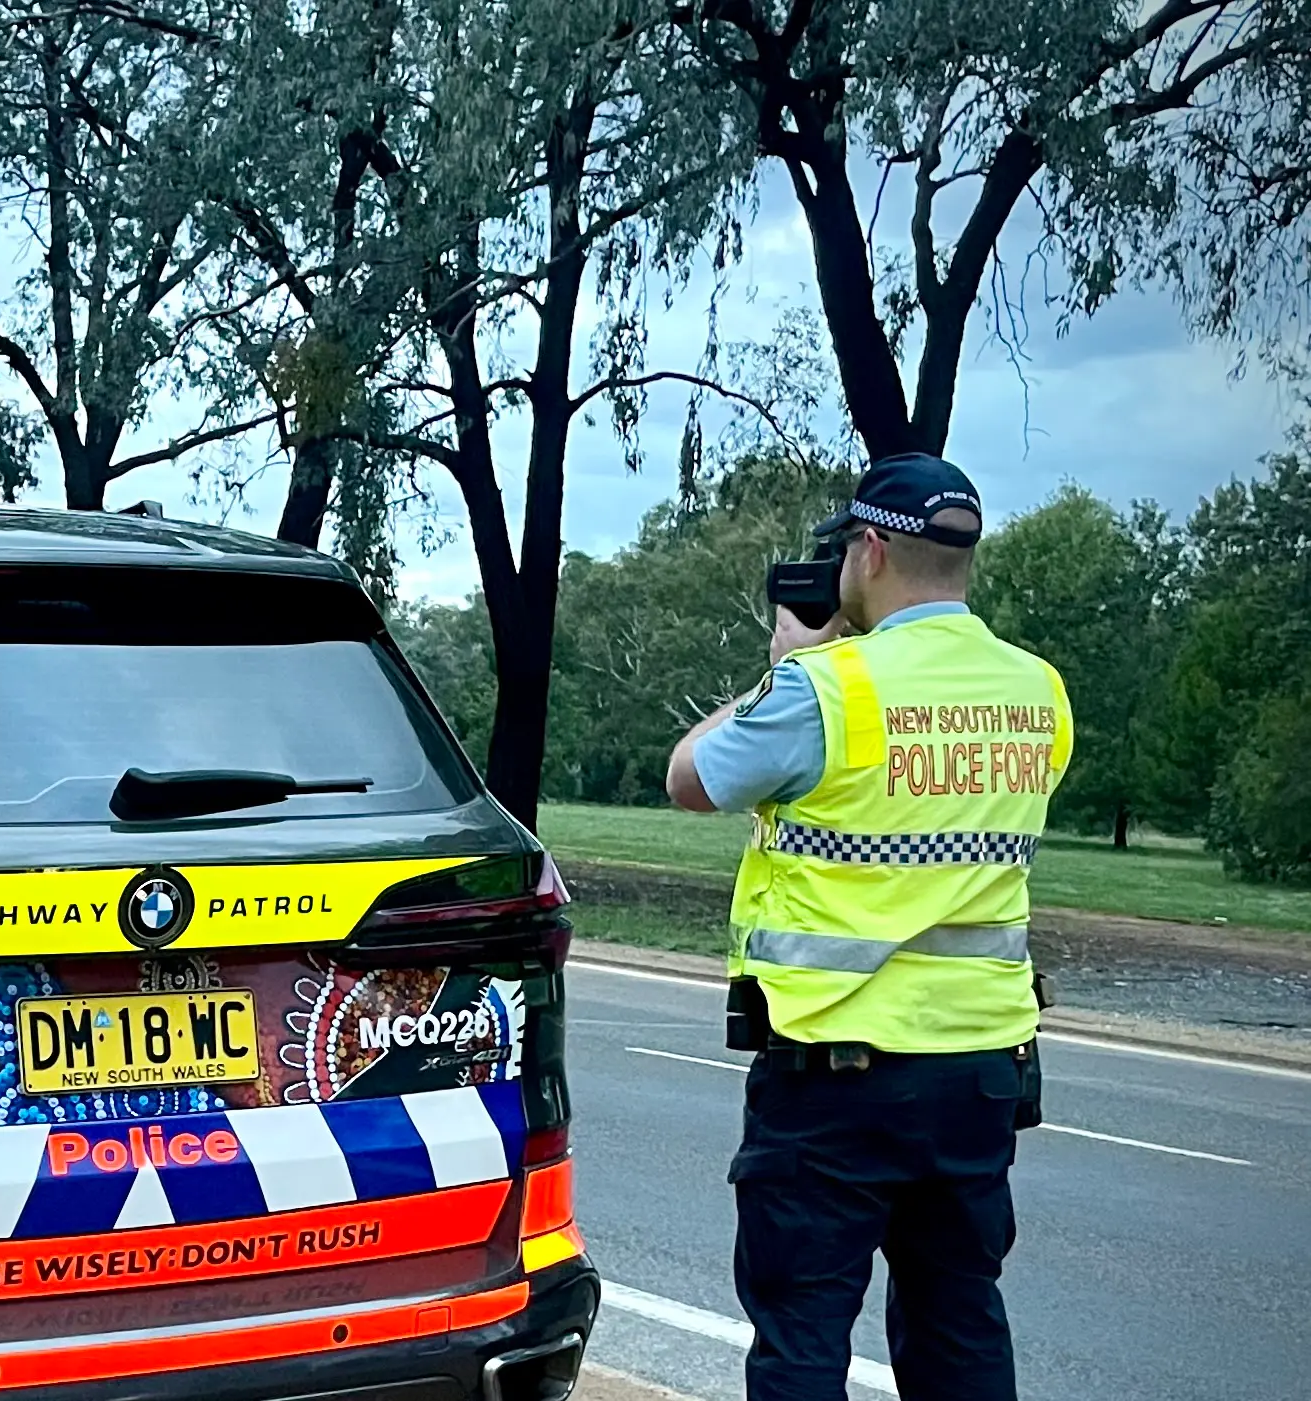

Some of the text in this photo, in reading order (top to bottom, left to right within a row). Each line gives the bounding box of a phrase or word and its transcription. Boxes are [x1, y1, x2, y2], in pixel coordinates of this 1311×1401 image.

[886, 704, 1056, 735] NEW SOUTH WALES
[887, 742, 984, 797] POLICE
[208, 893, 333, 918] PATROL
[358, 1007, 490, 1049] MCQ226
[61, 1063, 226, 1087] NEW SOUTH WALES
[47, 1125, 239, 1176] Police
[298, 1221, 381, 1255] RUSH
